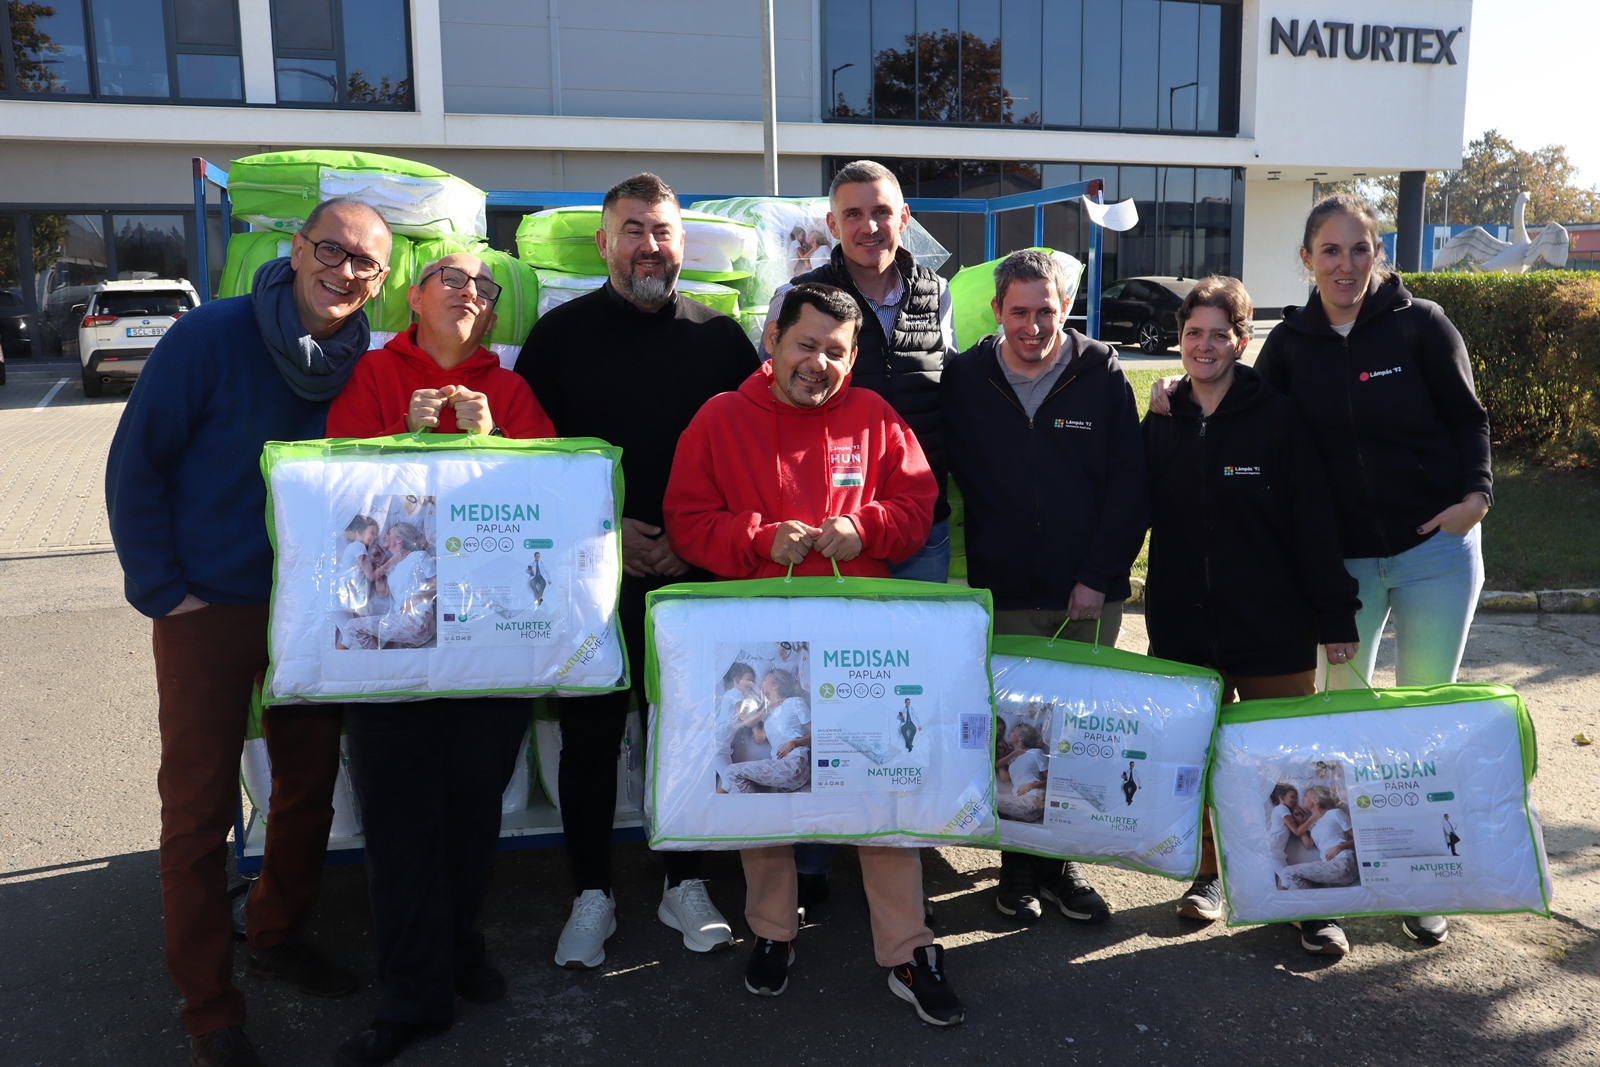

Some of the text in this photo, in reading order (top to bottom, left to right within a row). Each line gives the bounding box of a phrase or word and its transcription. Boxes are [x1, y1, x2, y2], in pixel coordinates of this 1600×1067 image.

[1270, 17, 1458, 65] NATURTEX
[132, 328, 165, 336] SCL-895
[830, 453, 861, 464] HUN
[451, 504, 540, 522] MEDISAN
[476, 524, 521, 533] PAPLAN
[495, 621, 551, 631] NATURTEX
[521, 630, 552, 639] HOME
[557, 632, 597, 678] NATURTEX
[580, 637, 604, 666] HOME
[823, 649, 910, 667] MEDISAN
[849, 670, 891, 679] PAPLAN
[1064, 713, 1139, 735] MEDISAN
[1084, 732, 1121, 744] PAPLAN
[867, 767, 922, 777] NATURTEX
[1354, 760, 1437, 782] MEDISAN
[891, 776, 922, 785] HOME
[1384, 780, 1421, 791] PÁRNA
[958, 803, 983, 830] HOME
[1091, 814, 1138, 826] NATURTEX
[1111, 823, 1137, 833] HOME
[1138, 833, 1179, 860] NATURTEX
[1160, 838, 1183, 857] HOME
[1411, 862, 1463, 872] NATURTEX
[1435, 870, 1464, 878] HOME
